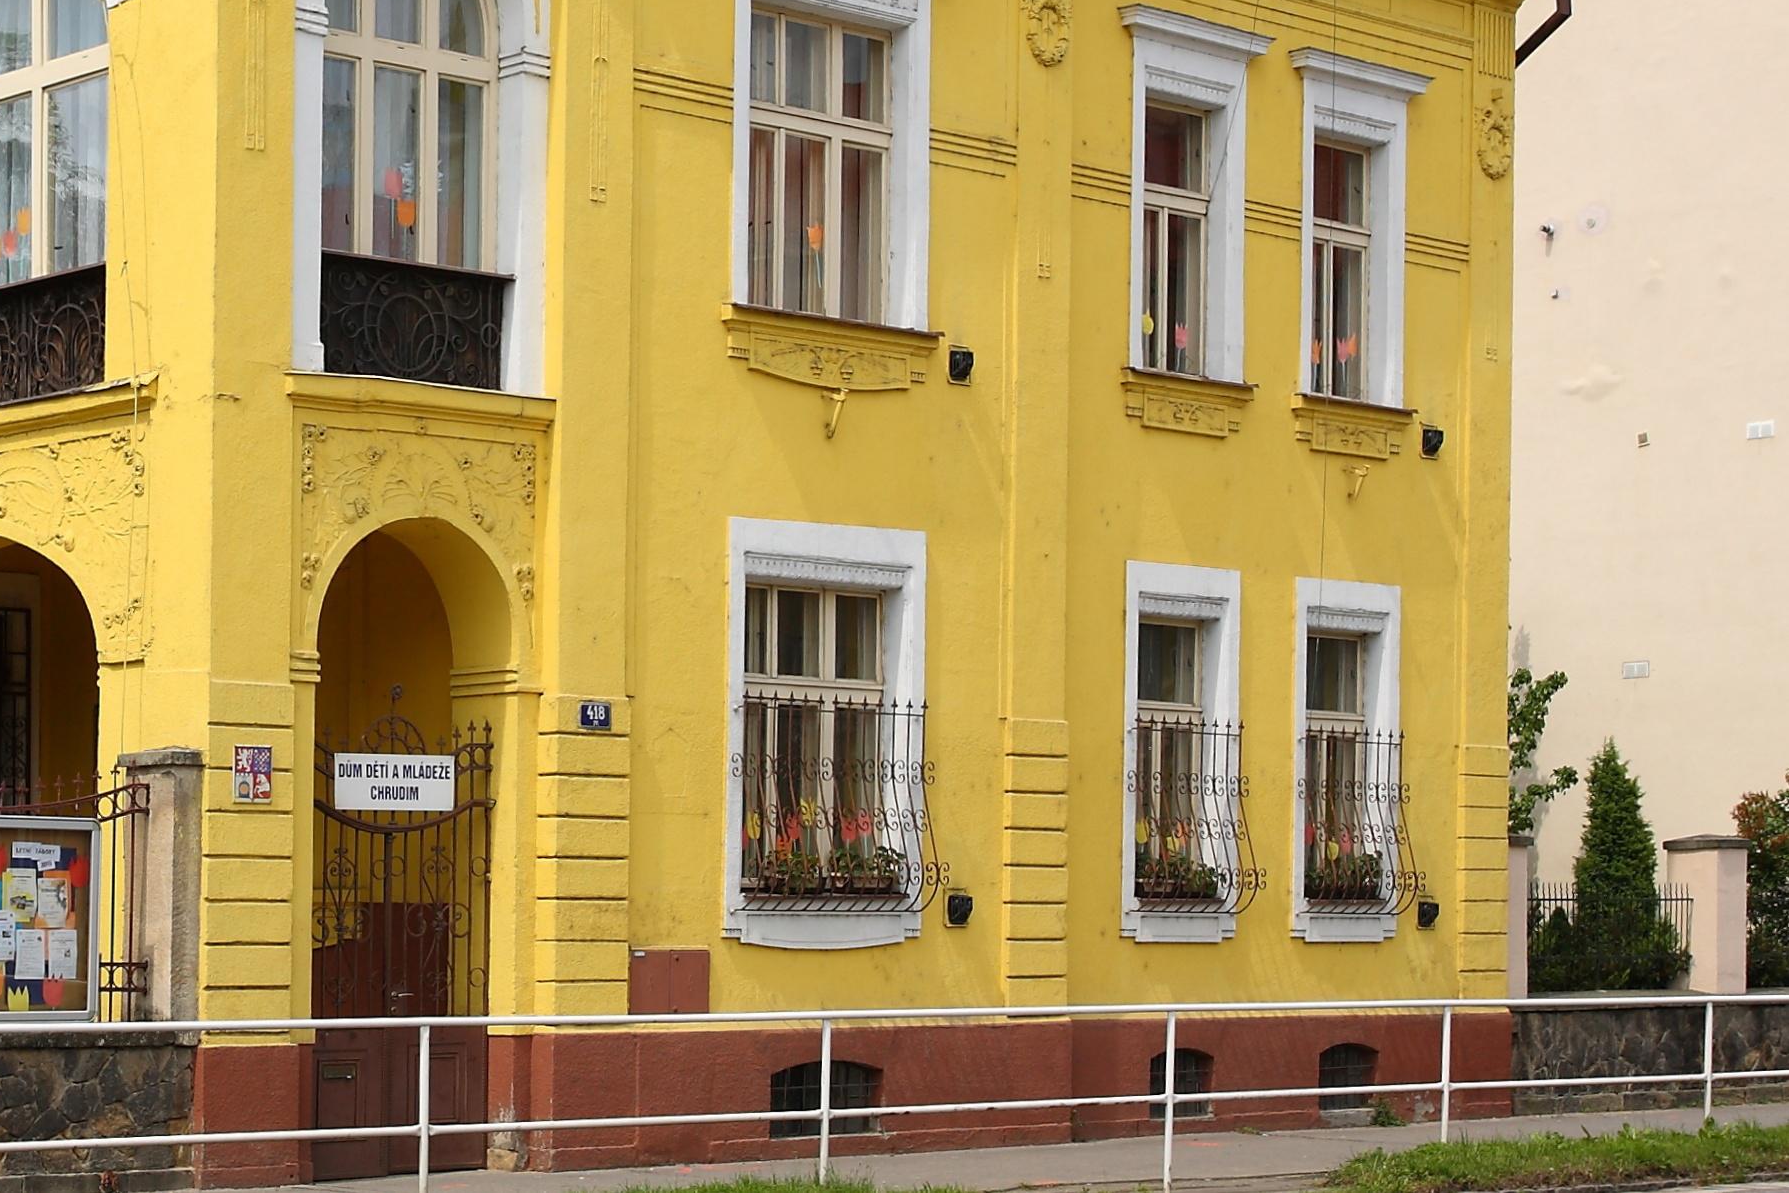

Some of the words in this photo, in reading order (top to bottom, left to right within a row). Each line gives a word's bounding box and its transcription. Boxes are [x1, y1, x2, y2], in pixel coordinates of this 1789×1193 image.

[586, 705, 606, 720] 418
[338, 760, 363, 778] DŮM
[366, 760, 389, 778] DĚTÍ
[392, 764, 399, 778] A
[402, 761, 451, 780] MLÁDEŽE
[370, 785, 419, 801] CHRUDIM
